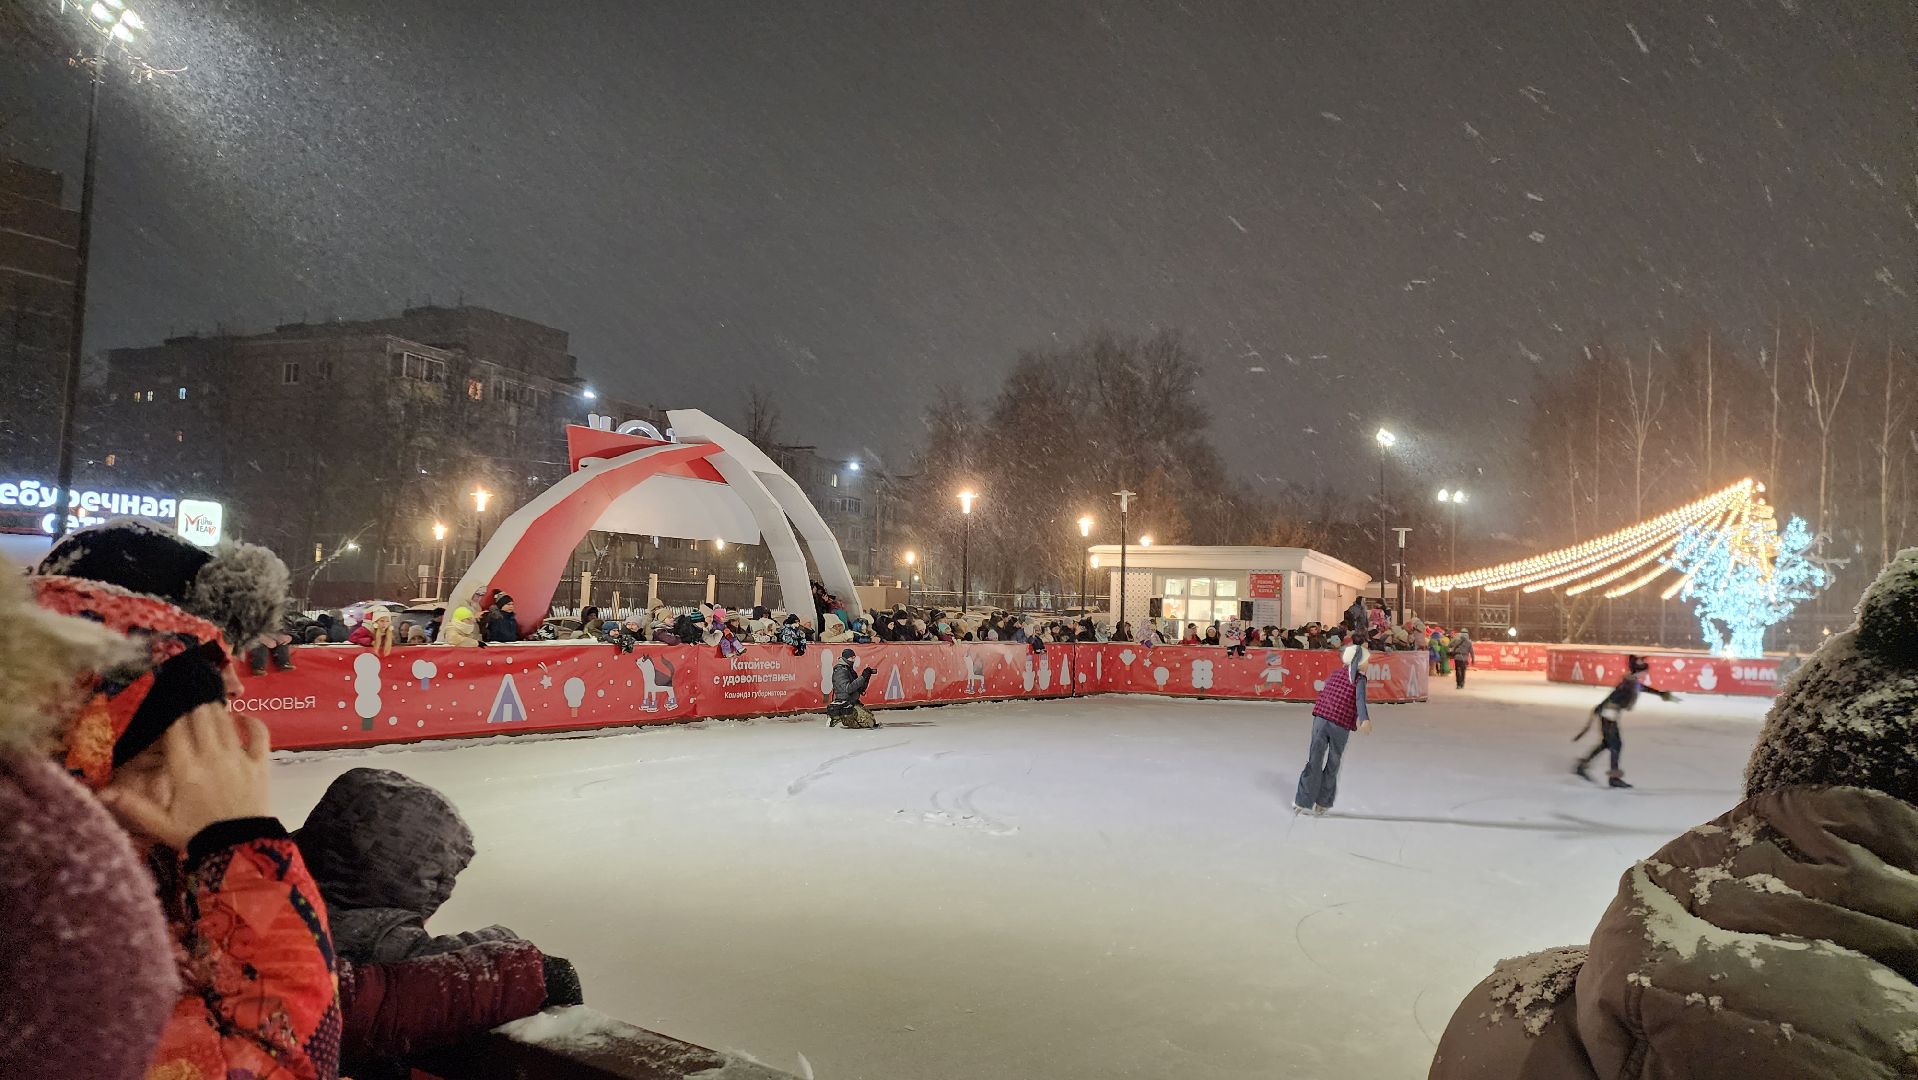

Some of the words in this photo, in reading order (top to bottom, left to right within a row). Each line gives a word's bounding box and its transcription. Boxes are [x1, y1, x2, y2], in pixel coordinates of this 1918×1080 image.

[730, 657, 780, 670] Катайтесь
[713, 675, 720, 685] с
[722, 673, 796, 688] удовольствием
[724, 691, 751, 699] Команда
[751, 690, 787, 699] губернатора
[227, 696, 316, 712] ОСКОВЬЯ
